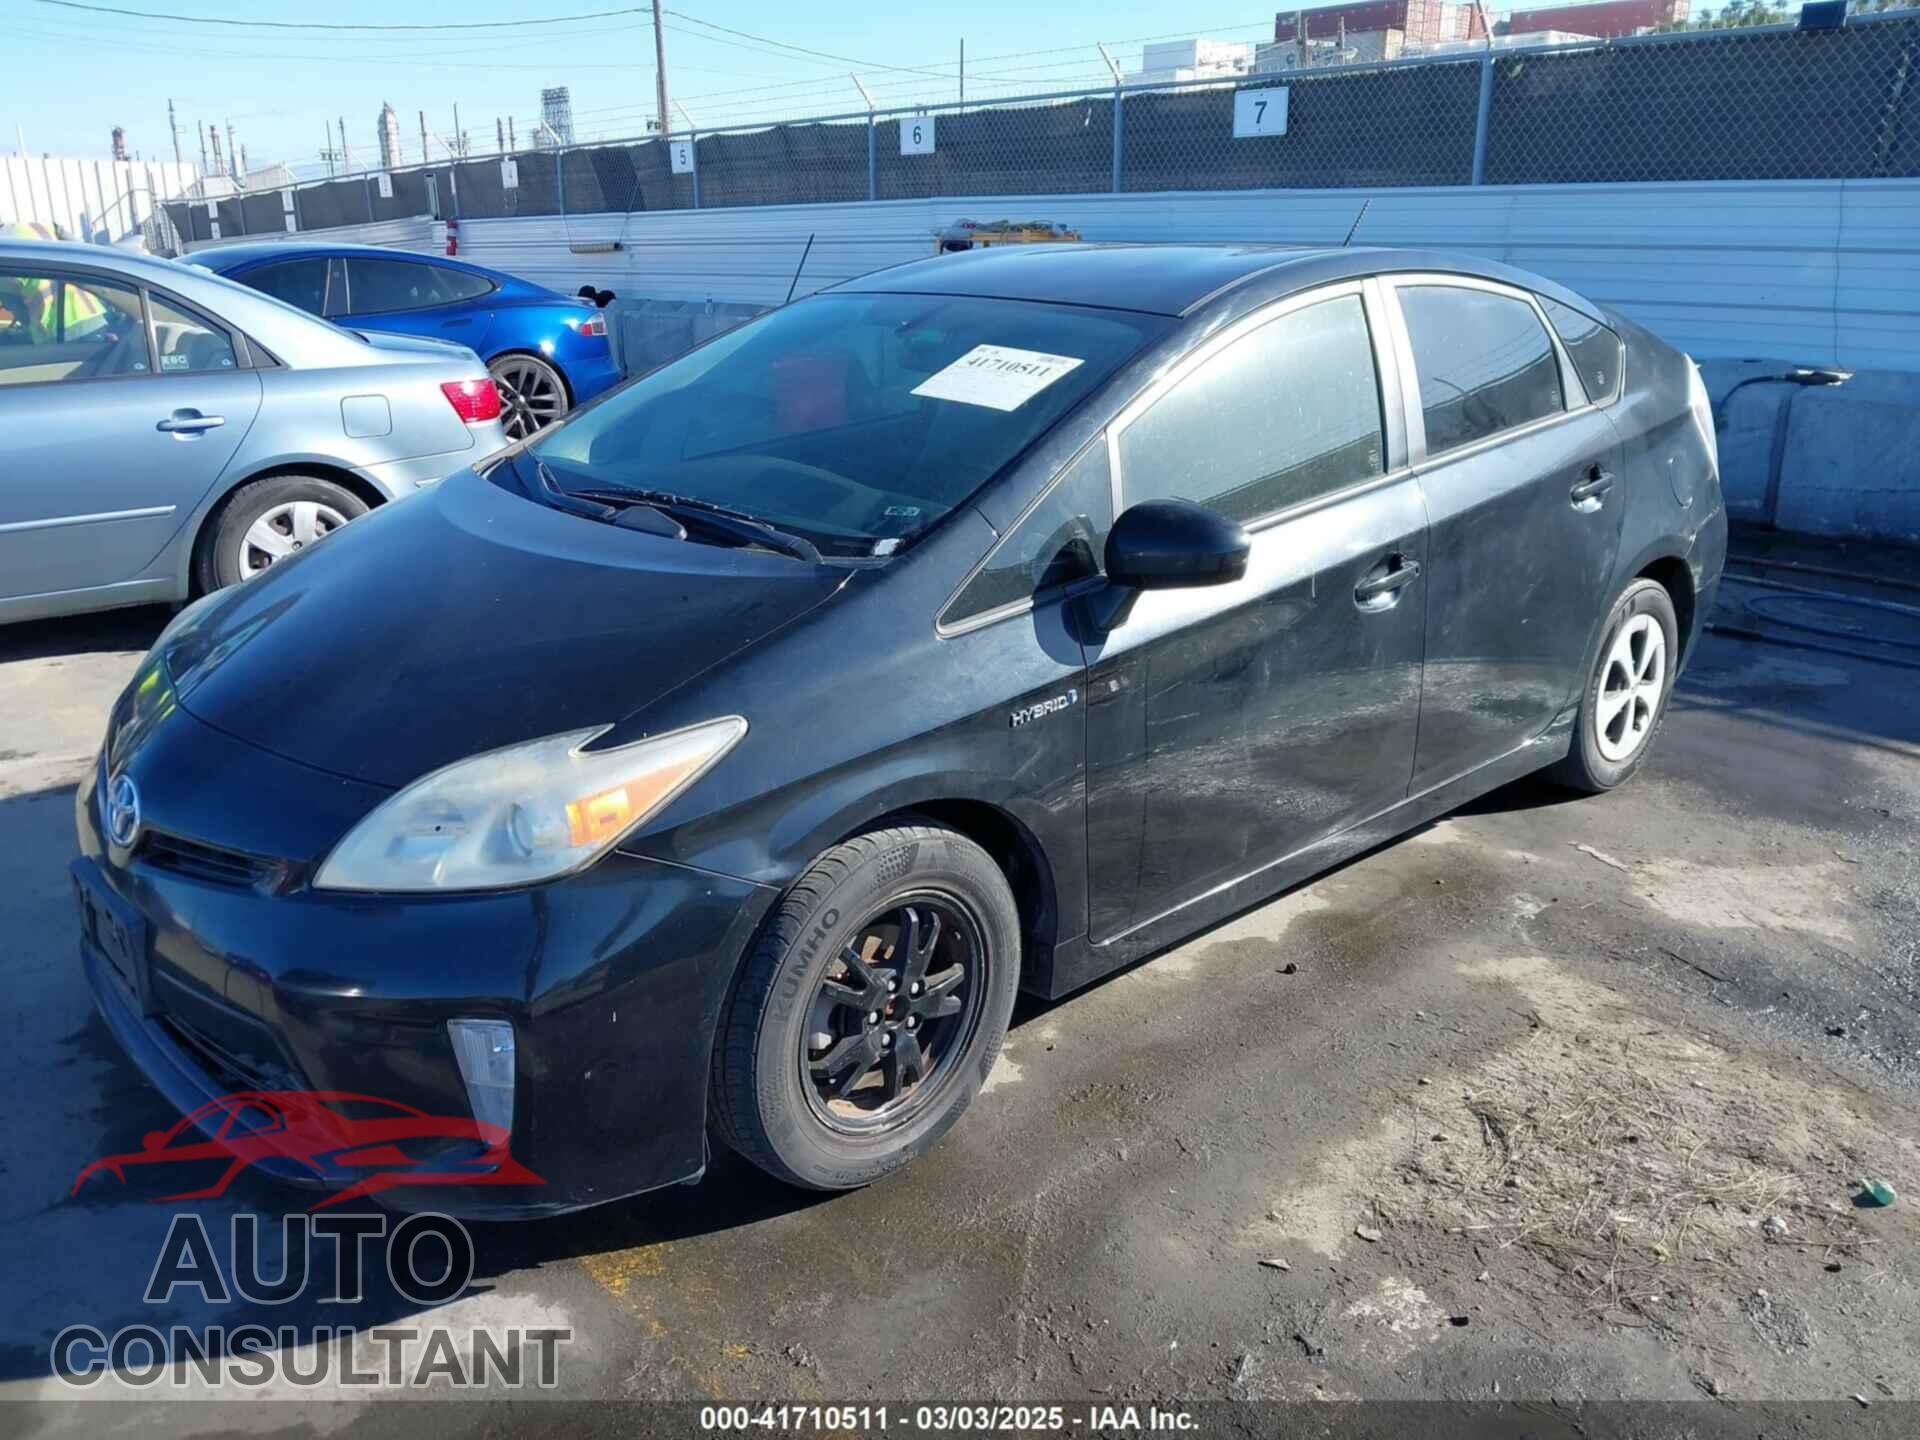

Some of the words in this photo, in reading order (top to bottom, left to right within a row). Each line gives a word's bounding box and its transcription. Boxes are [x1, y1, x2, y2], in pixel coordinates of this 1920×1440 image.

[1254, 101, 1268, 124] 7
[913, 126, 922, 145] 6
[679, 149, 687, 165] 5
[966, 356, 1051, 377] 41710511
[1010, 694, 1069, 728] HYBRID
[771, 907, 840, 1023] KUMHO
